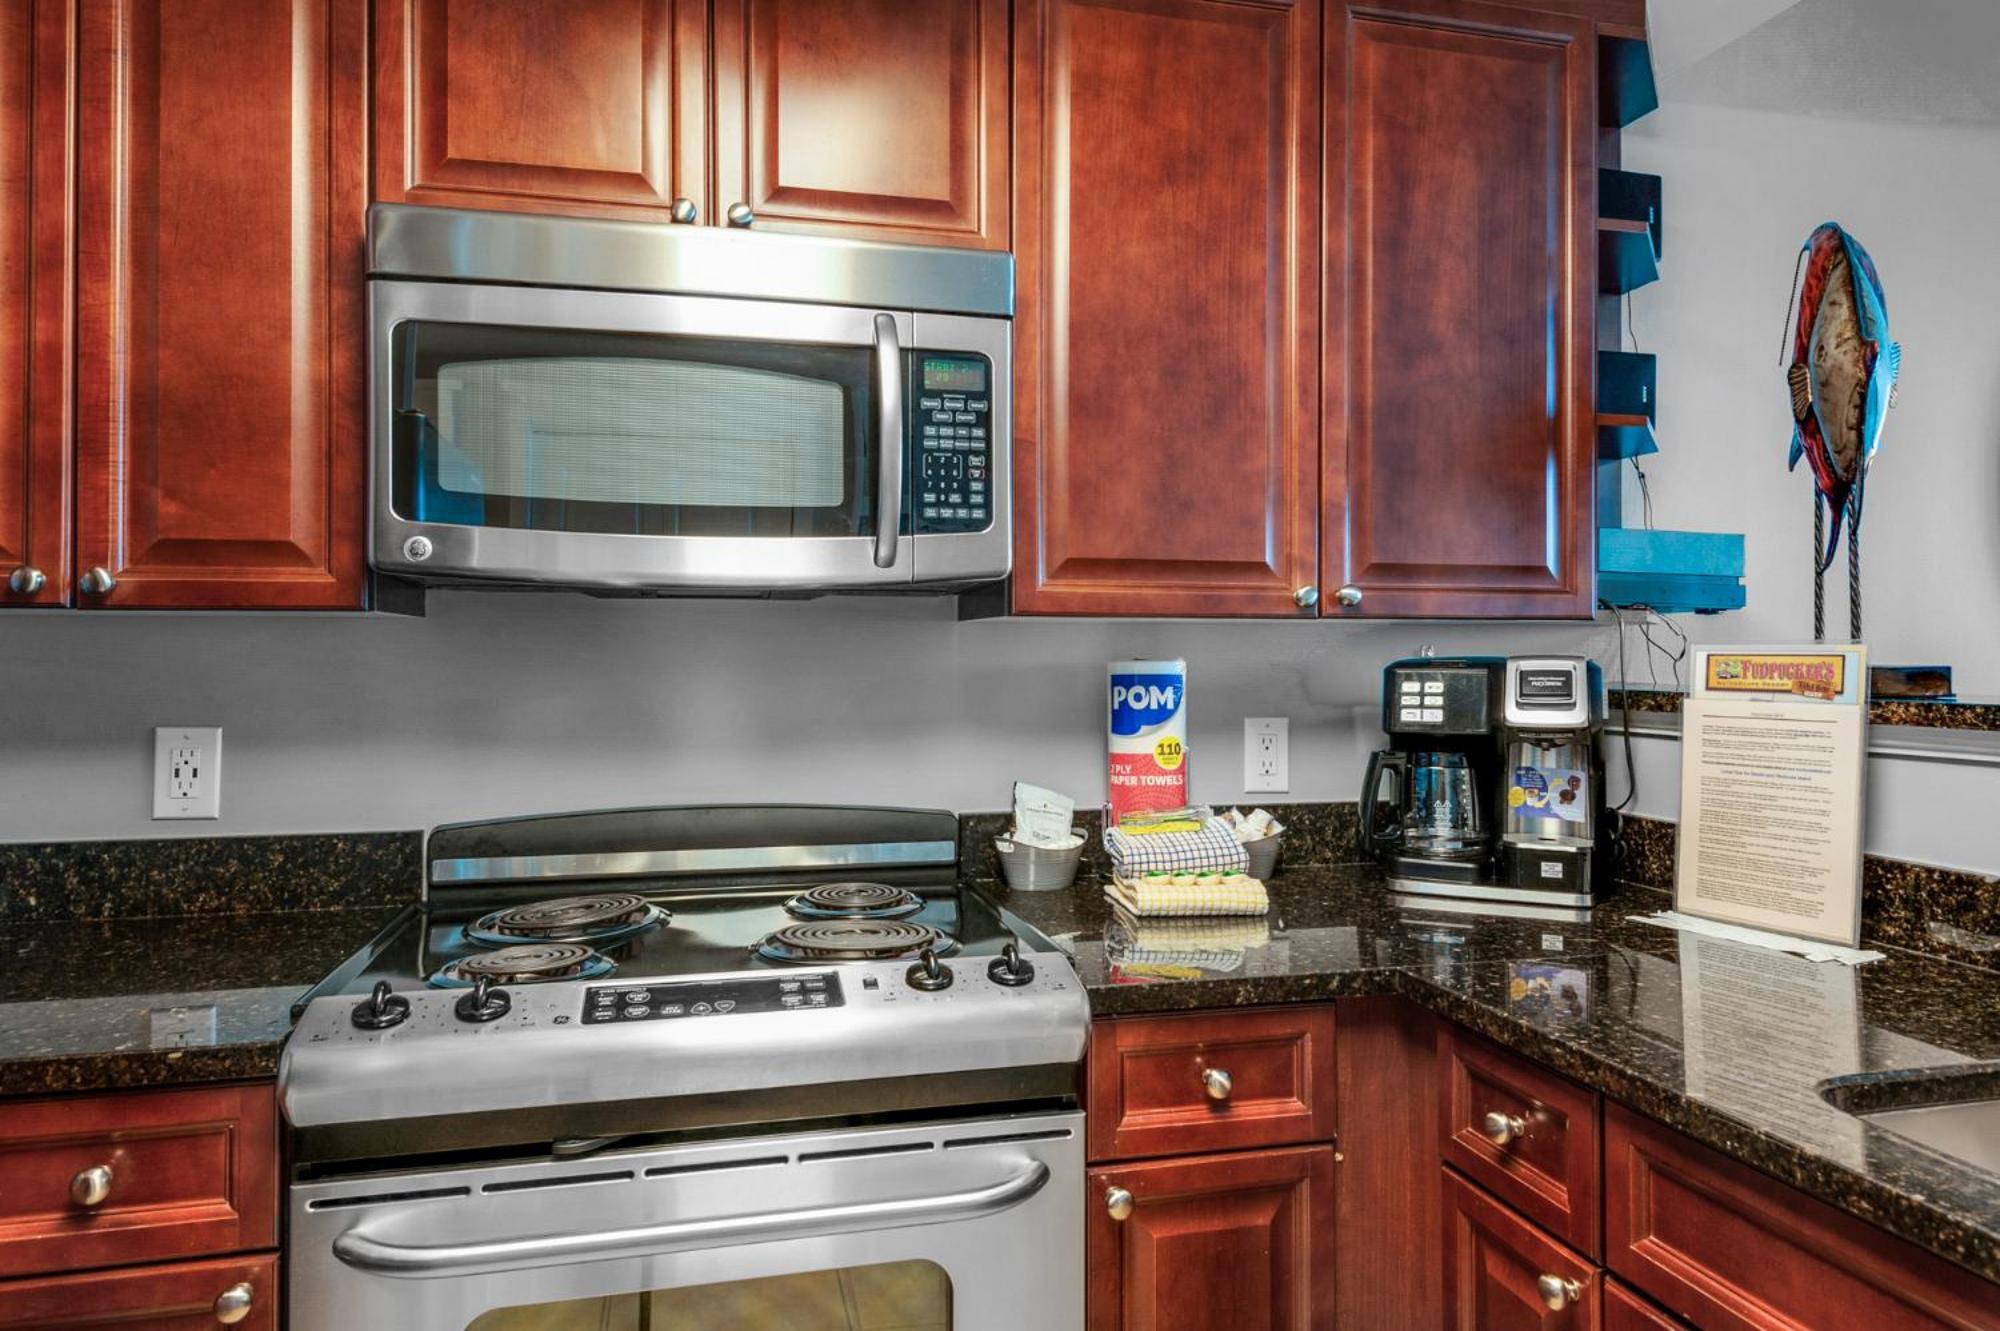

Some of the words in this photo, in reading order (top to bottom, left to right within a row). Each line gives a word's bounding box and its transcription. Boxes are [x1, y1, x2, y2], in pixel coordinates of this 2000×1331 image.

[1113, 685, 1174, 710] POM
[1158, 742, 1181, 756] 110
[1115, 764, 1132, 775] PLY
[1141, 775, 1183, 786] TOWELS
